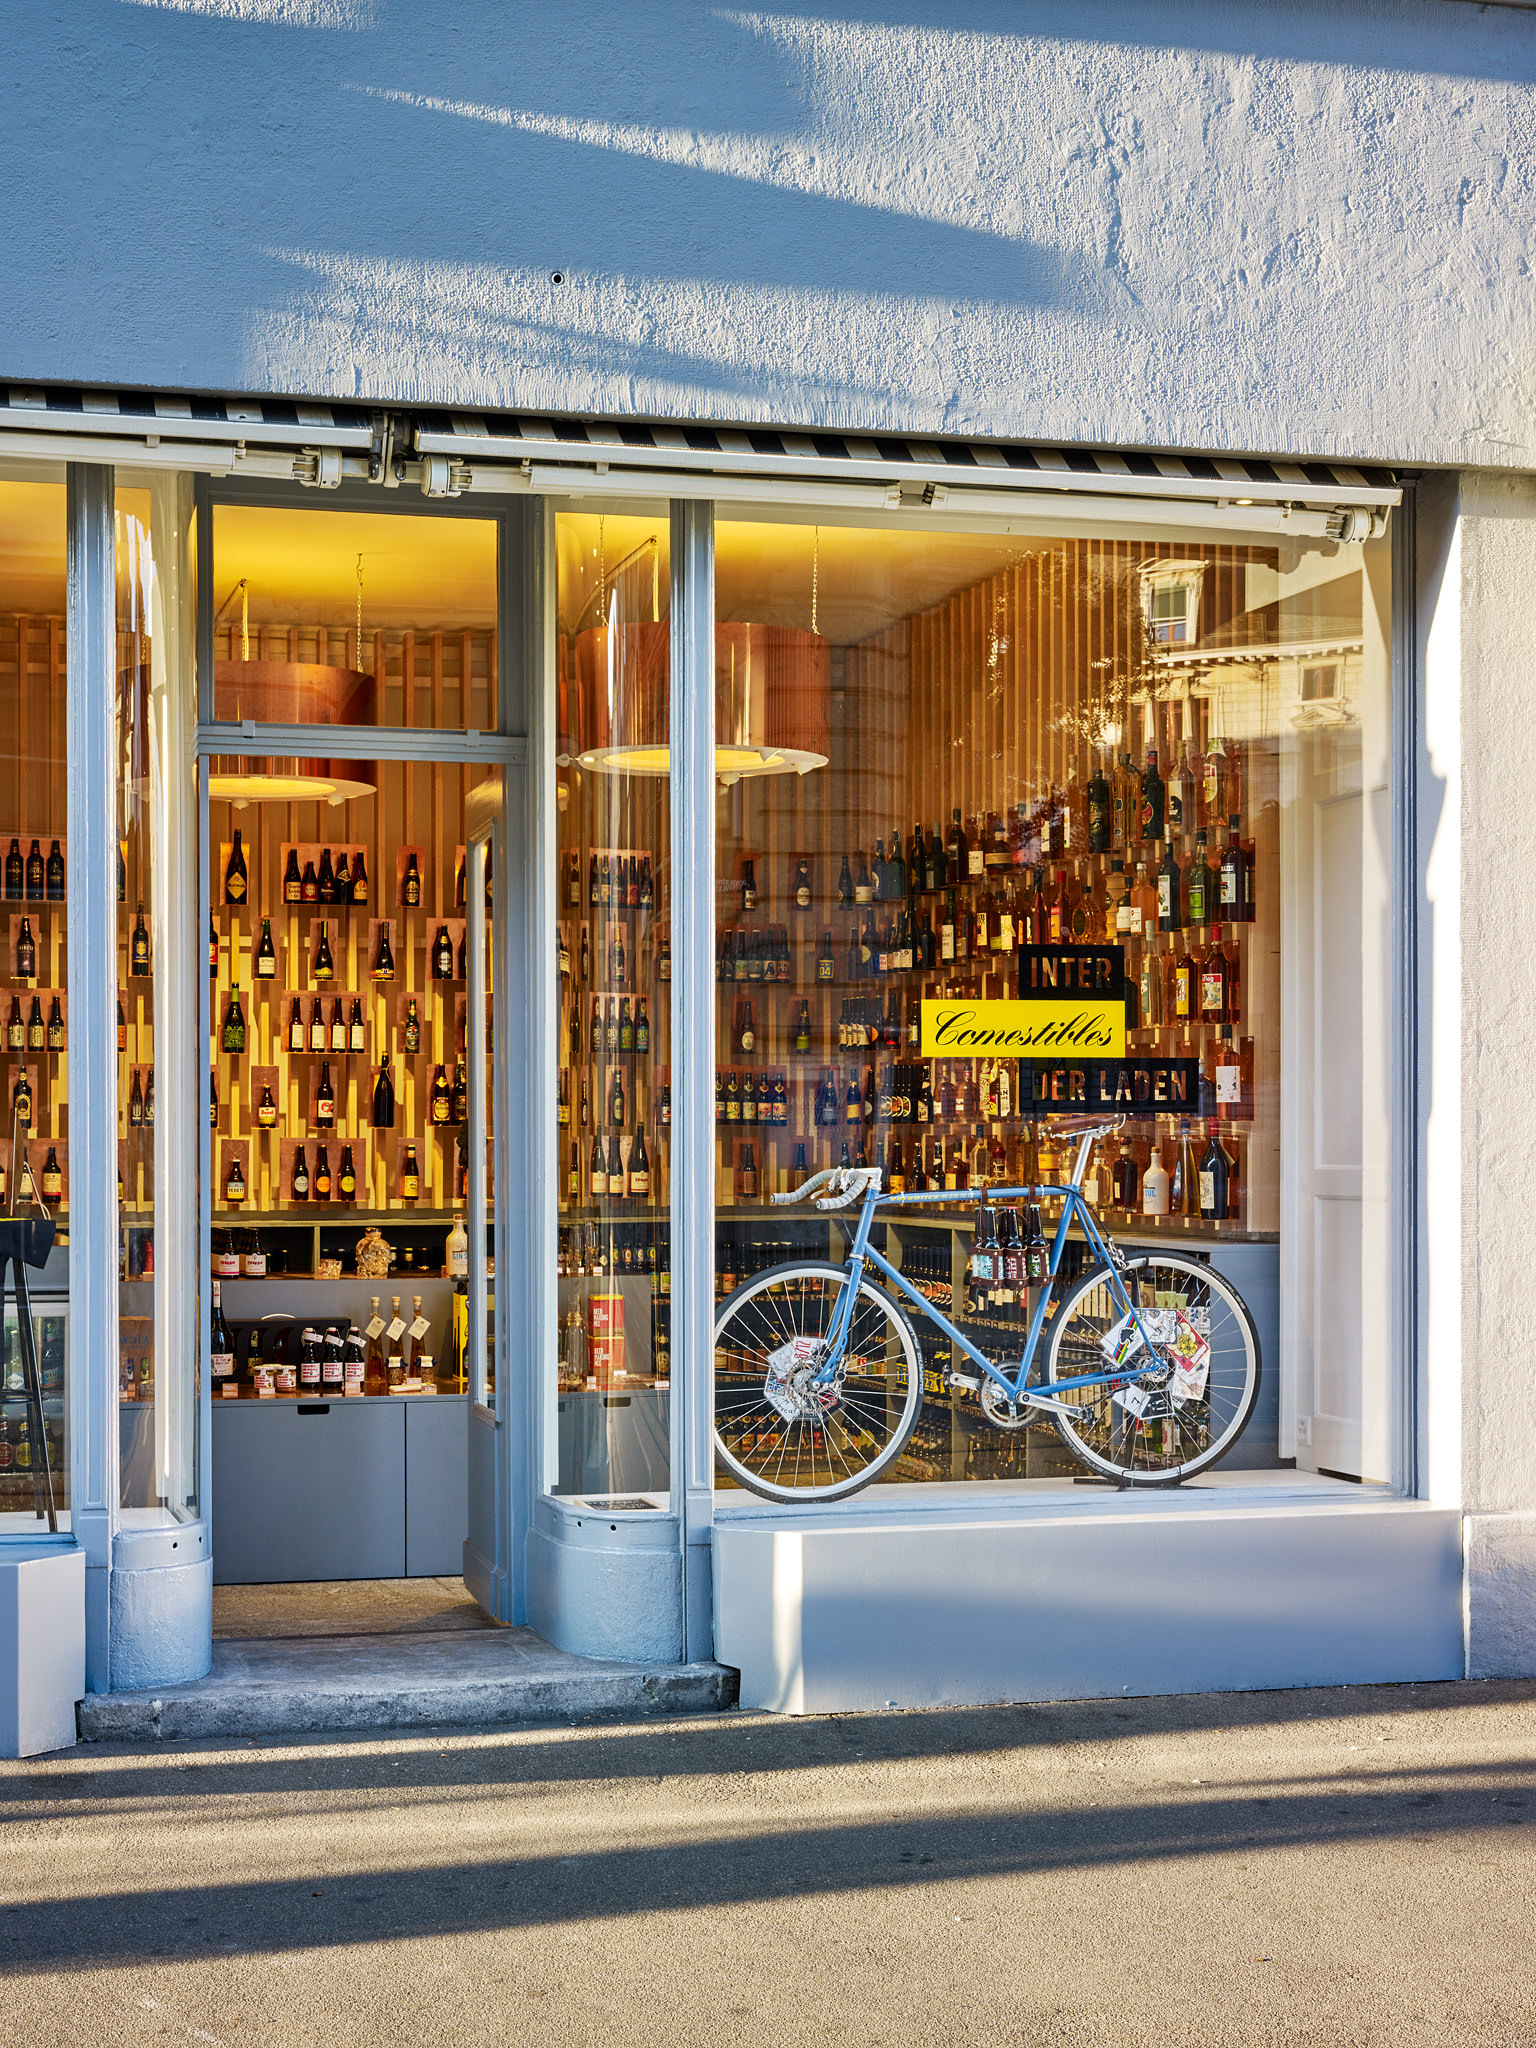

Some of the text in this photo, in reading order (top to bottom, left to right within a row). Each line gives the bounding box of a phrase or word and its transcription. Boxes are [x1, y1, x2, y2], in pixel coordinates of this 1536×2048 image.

[1031, 956, 1112, 989] INTER
[935, 1009, 1113, 1047] Comestibles
[1033, 1069, 1188, 1101] DER LADEN
